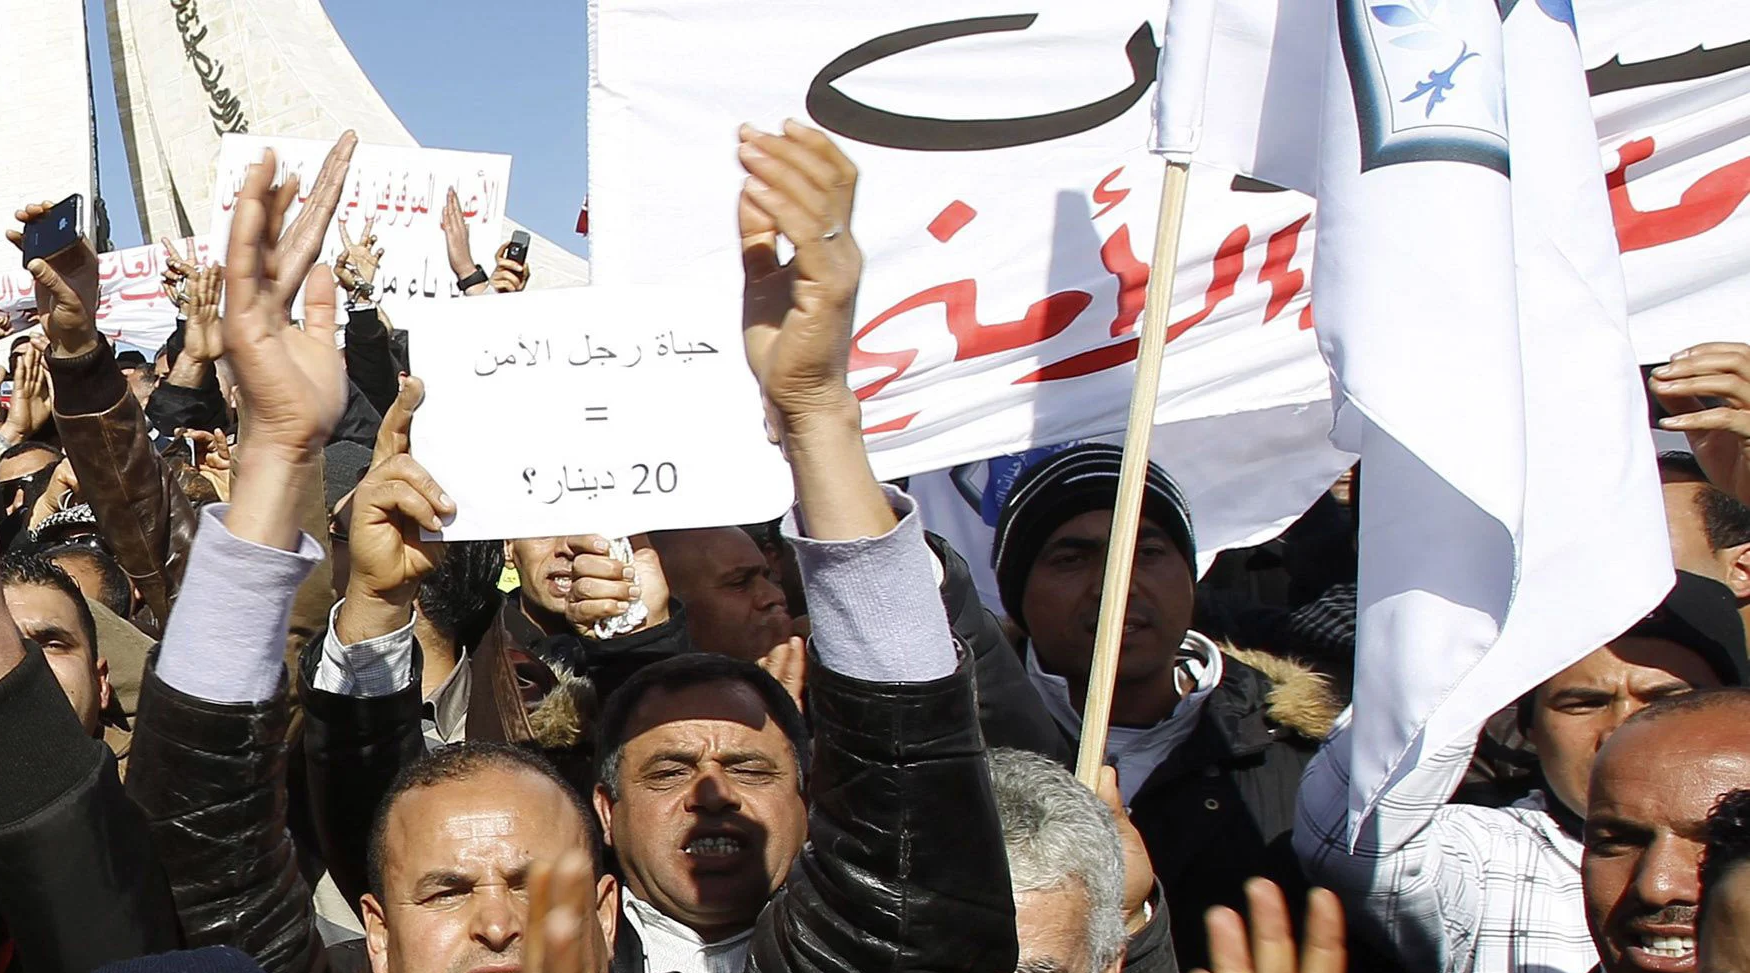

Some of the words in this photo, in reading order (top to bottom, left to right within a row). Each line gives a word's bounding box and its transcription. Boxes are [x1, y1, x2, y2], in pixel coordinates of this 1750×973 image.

[567, 334, 643, 368] رجل
[654, 330, 719, 364] حياة
[631, 461, 679, 495] 20
